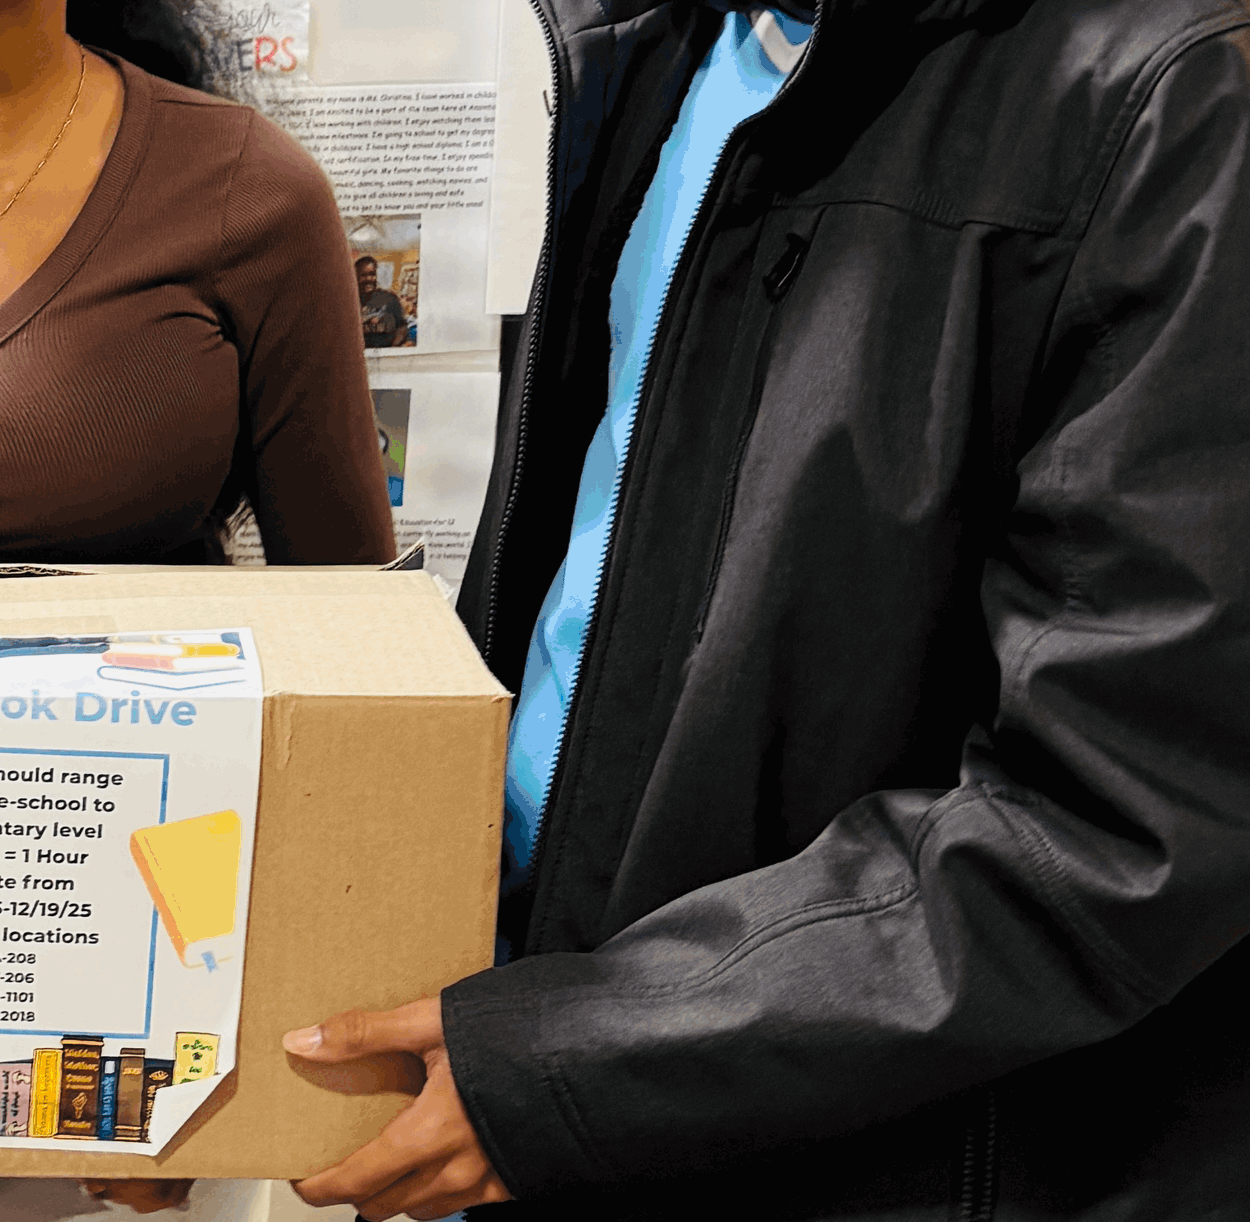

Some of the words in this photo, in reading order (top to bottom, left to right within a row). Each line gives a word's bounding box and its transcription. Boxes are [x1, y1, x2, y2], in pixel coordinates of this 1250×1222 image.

[75, 691, 196, 726] Drive
[61, 773, 123, 788] range
[94, 799, 115, 812] to
[53, 822, 102, 838] level
[22, 849, 29, 862] 1
[37, 849, 89, 864] Hour
[23, 875, 74, 890] from
[3, 927, 99, 944] locations
